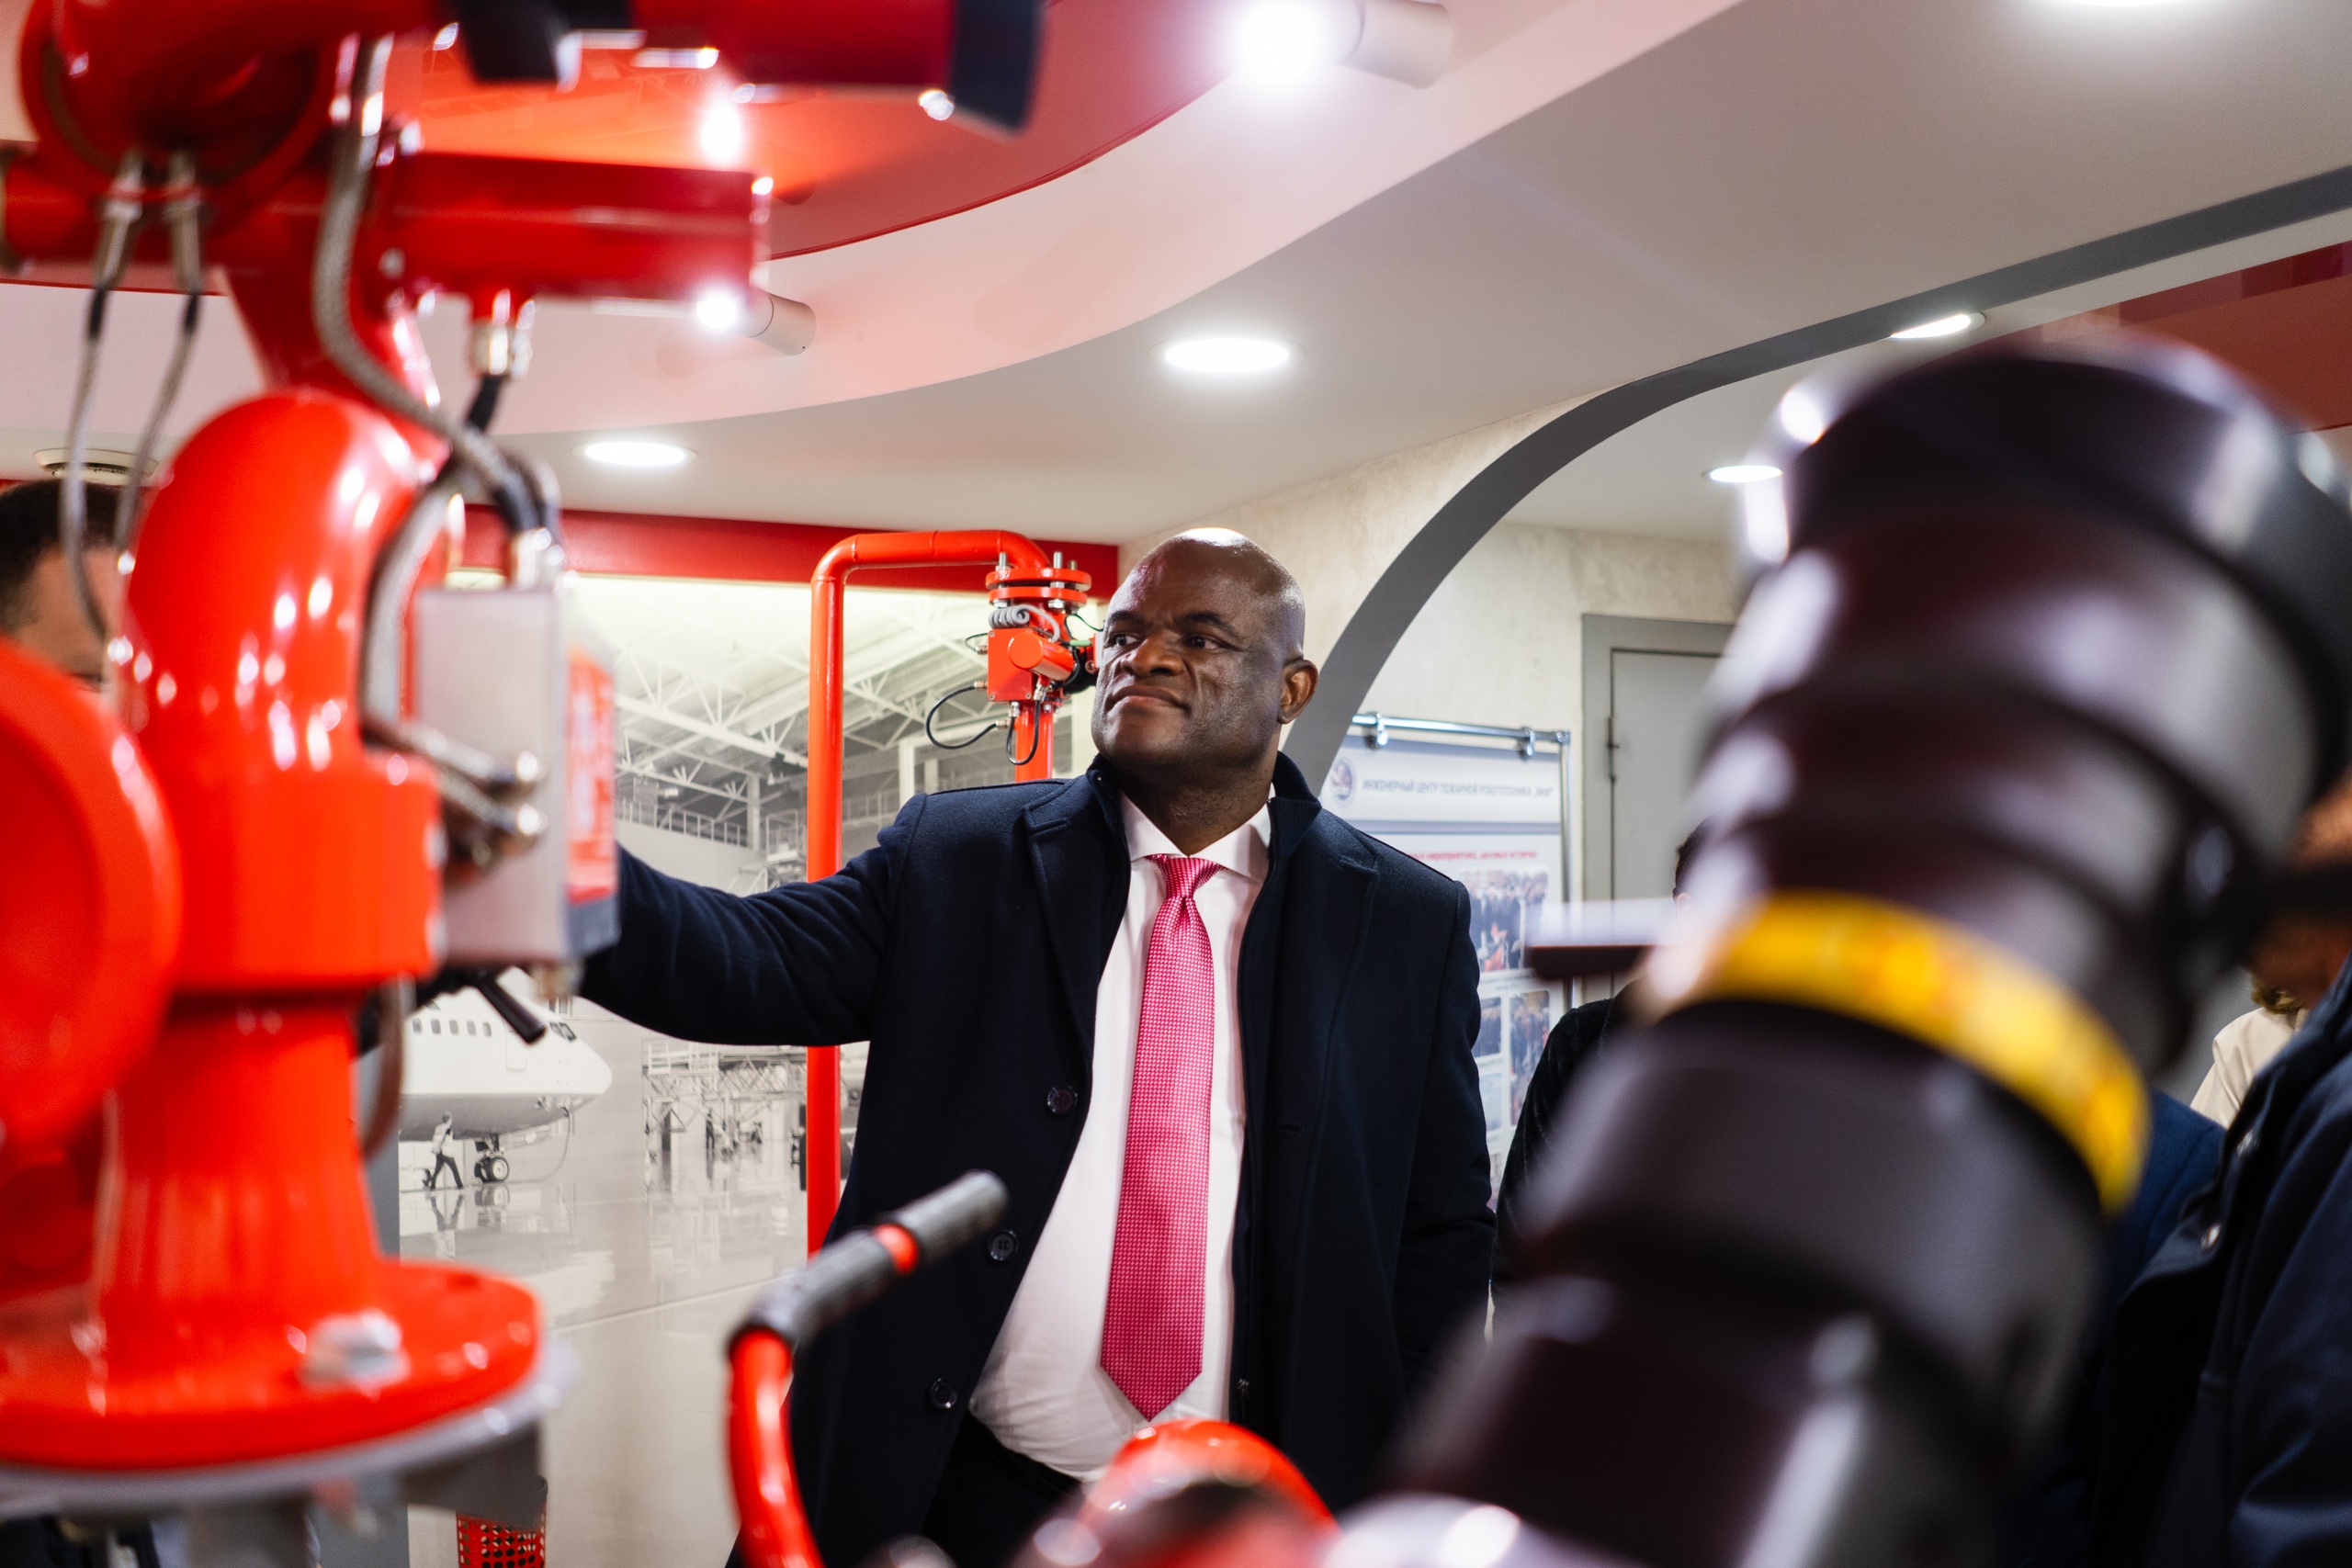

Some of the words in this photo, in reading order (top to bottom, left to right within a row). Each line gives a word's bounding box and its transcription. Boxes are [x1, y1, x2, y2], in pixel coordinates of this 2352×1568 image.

[1362, 779, 1414, 793] ИНЖЕНЕРНЫЙ
[1417, 782, 1438, 795] ЦЕНТР
[1441, 783, 1477, 795] ПОЖАРНОЙ
